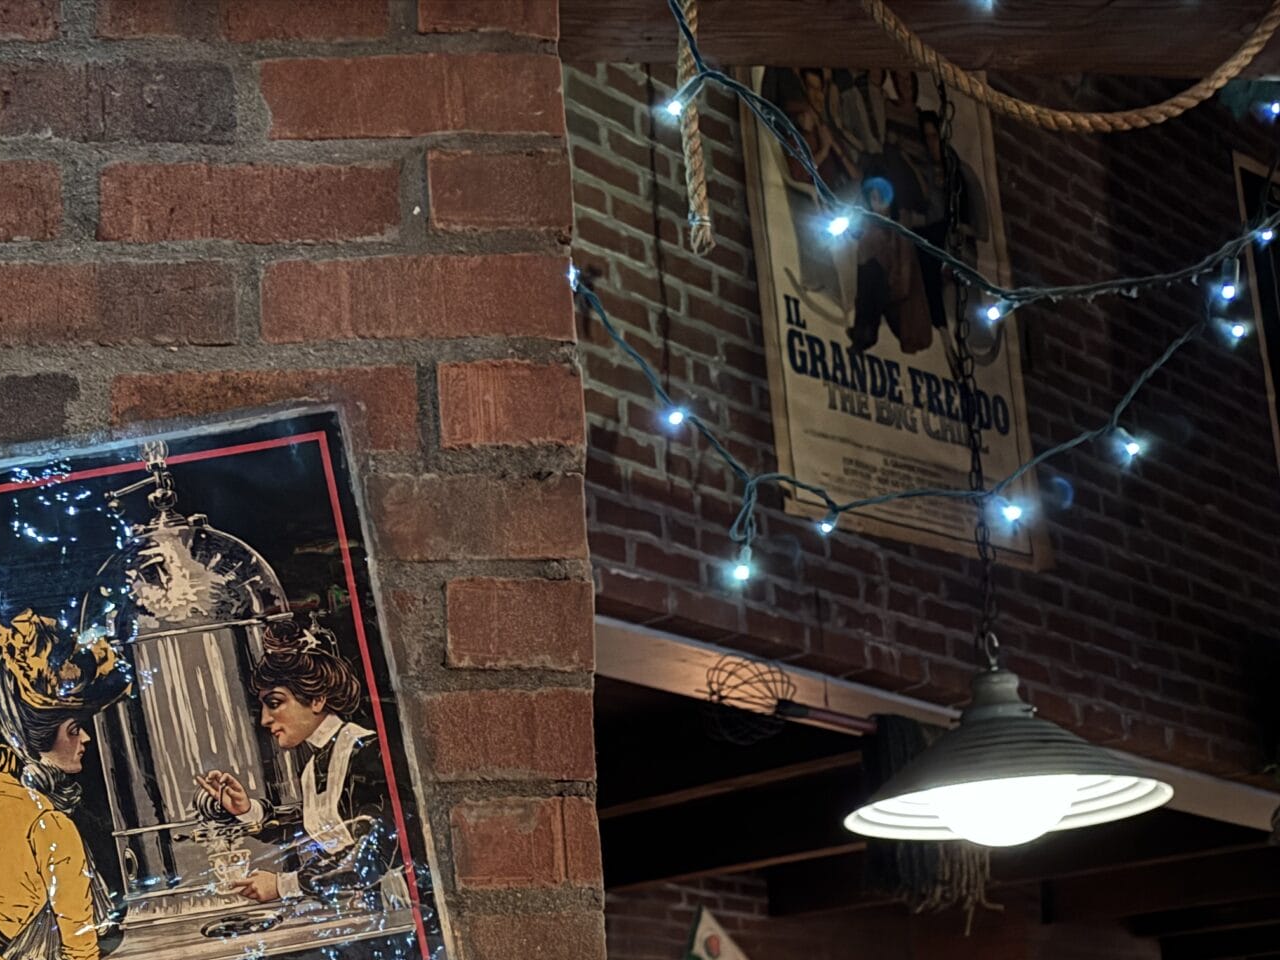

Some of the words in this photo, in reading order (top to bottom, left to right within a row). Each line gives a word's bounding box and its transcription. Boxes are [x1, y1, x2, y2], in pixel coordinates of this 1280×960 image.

[783, 294, 807, 330] IL
[786, 328, 904, 405] GRANDE
[824, 382, 872, 421] THE
[874, 401, 919, 435] BIG
